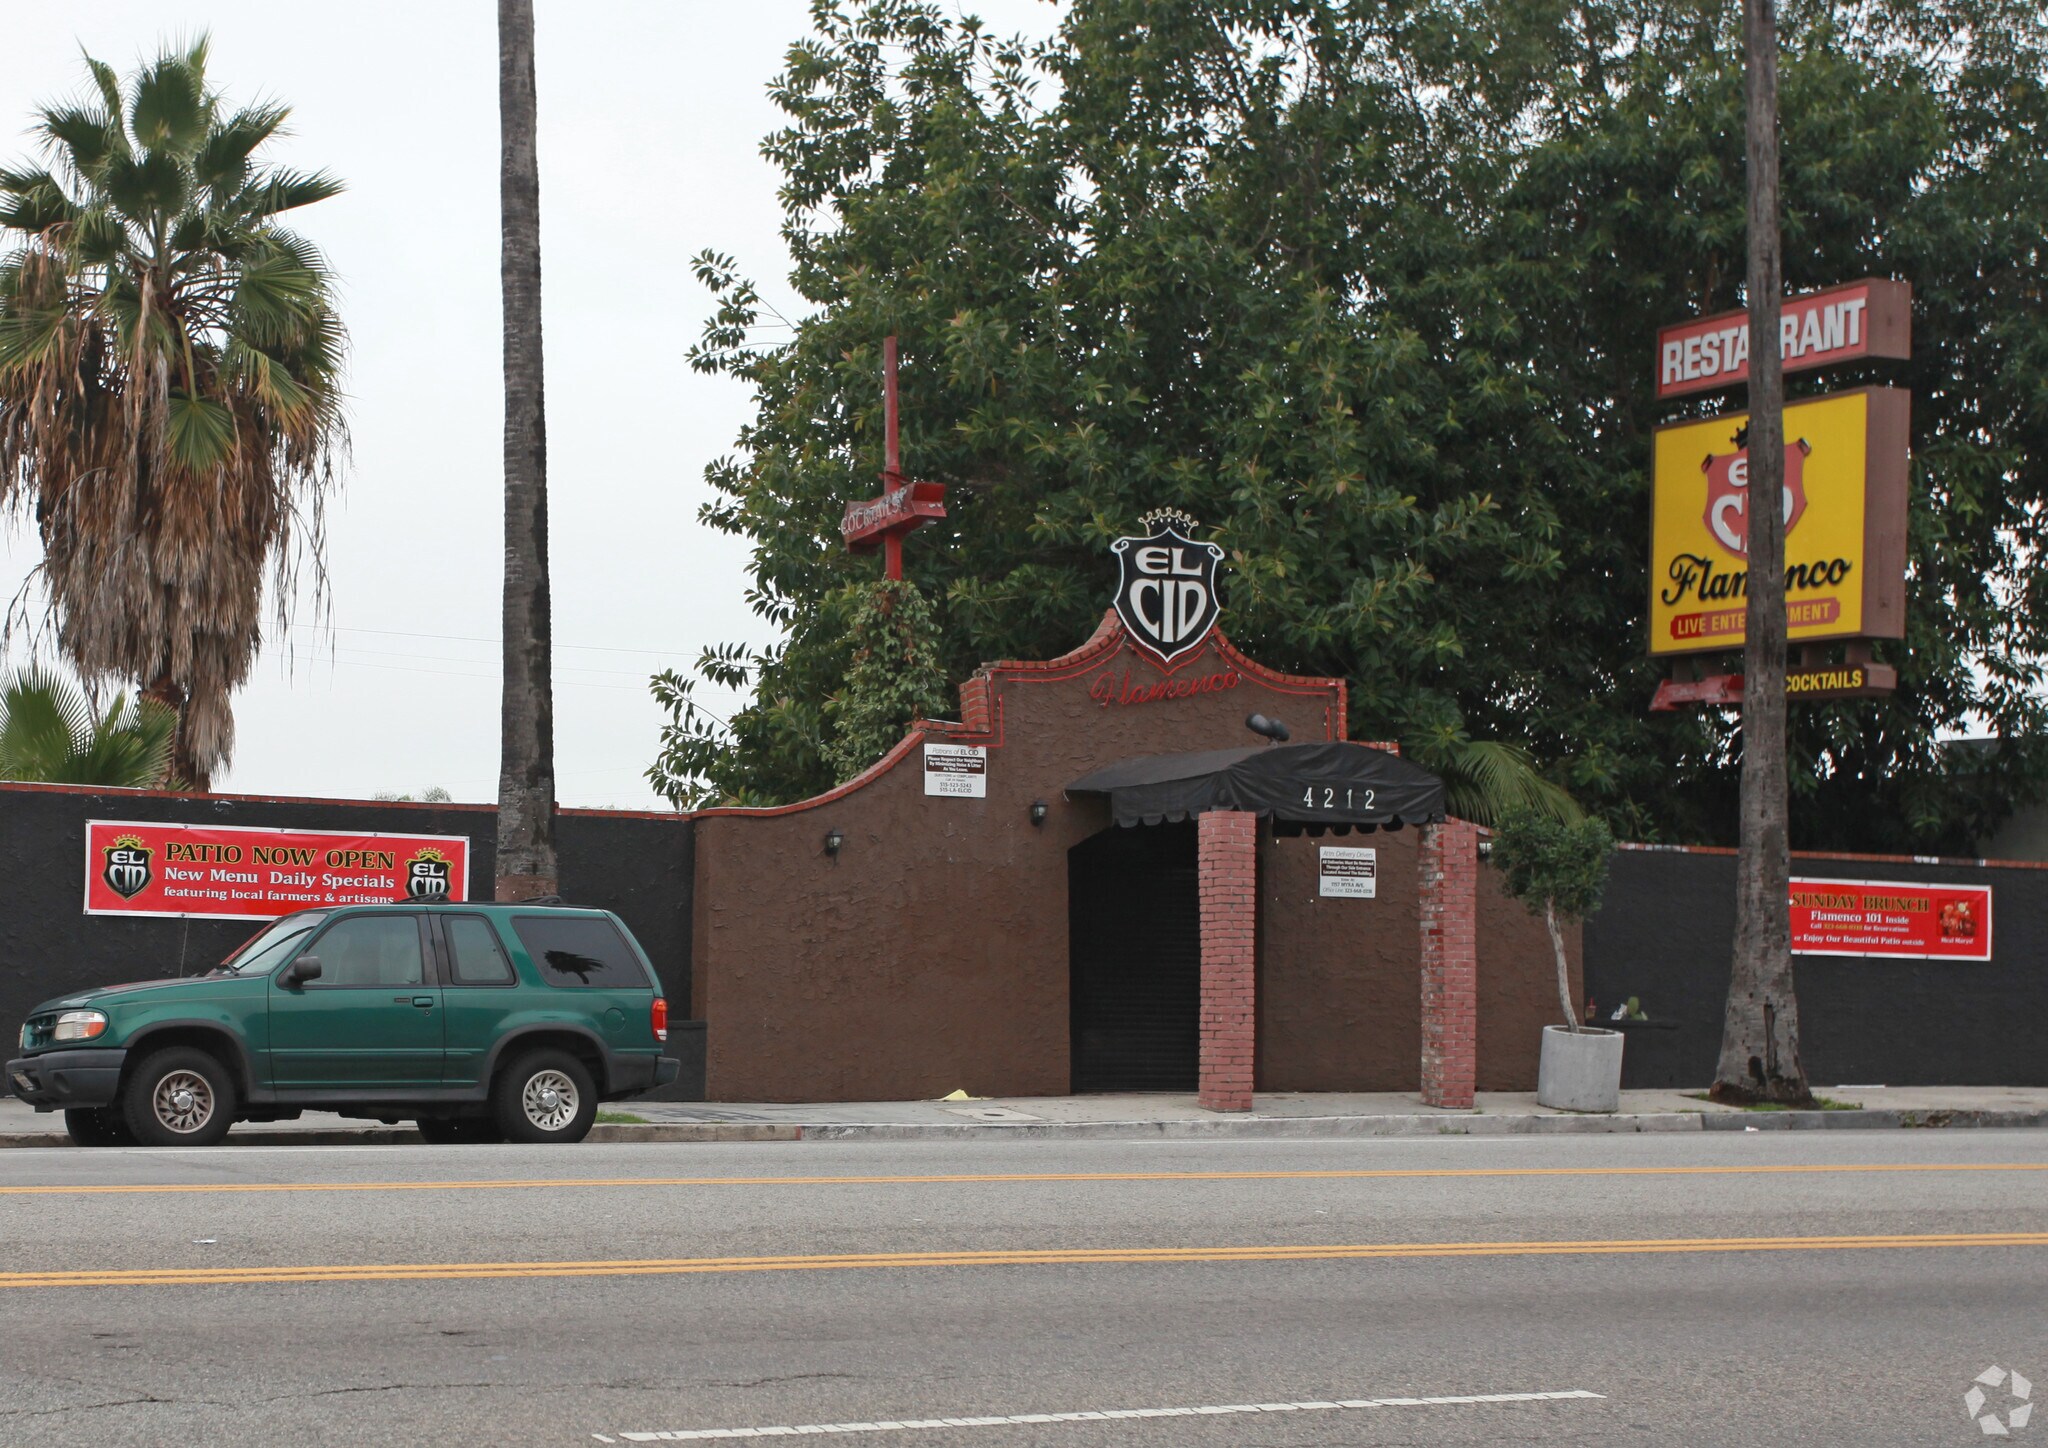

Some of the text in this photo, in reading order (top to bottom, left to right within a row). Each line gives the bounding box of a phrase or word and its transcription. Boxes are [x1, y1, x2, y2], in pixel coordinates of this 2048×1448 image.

[1662, 297, 1866, 385] RESTARANT
[840, 498, 900, 535] COCKTAILS
[1135, 546, 1203, 576] EL
[1129, 578, 1207, 643] CID
[1677, 602, 1831, 635] LIVE ENTEMENT
[1090, 668, 1240, 709] Flamenco
[1303, 787, 1375, 810] 4212
[111, 850, 145, 864] EL
[164, 842, 395, 870] PATIO NOW OPEN
[108, 864, 147, 893] CID
[164, 867, 395, 890] New Menu Daily Specials
[413, 863, 444, 876] EL
[164, 886, 394, 904] featuring local farmers & artisans
[410, 877, 445, 896] CID
[1792, 892, 1930, 913] SUNDAY BRUNCH
[1811, 910, 1909, 924] Flamenco 101 Inside
[1803, 934, 1824, 943] Enjoy
[1826, 934, 1840, 942] Our
[1843, 935, 1879, 944] Beautiful
[1881, 937, 1900, 945] Patio
